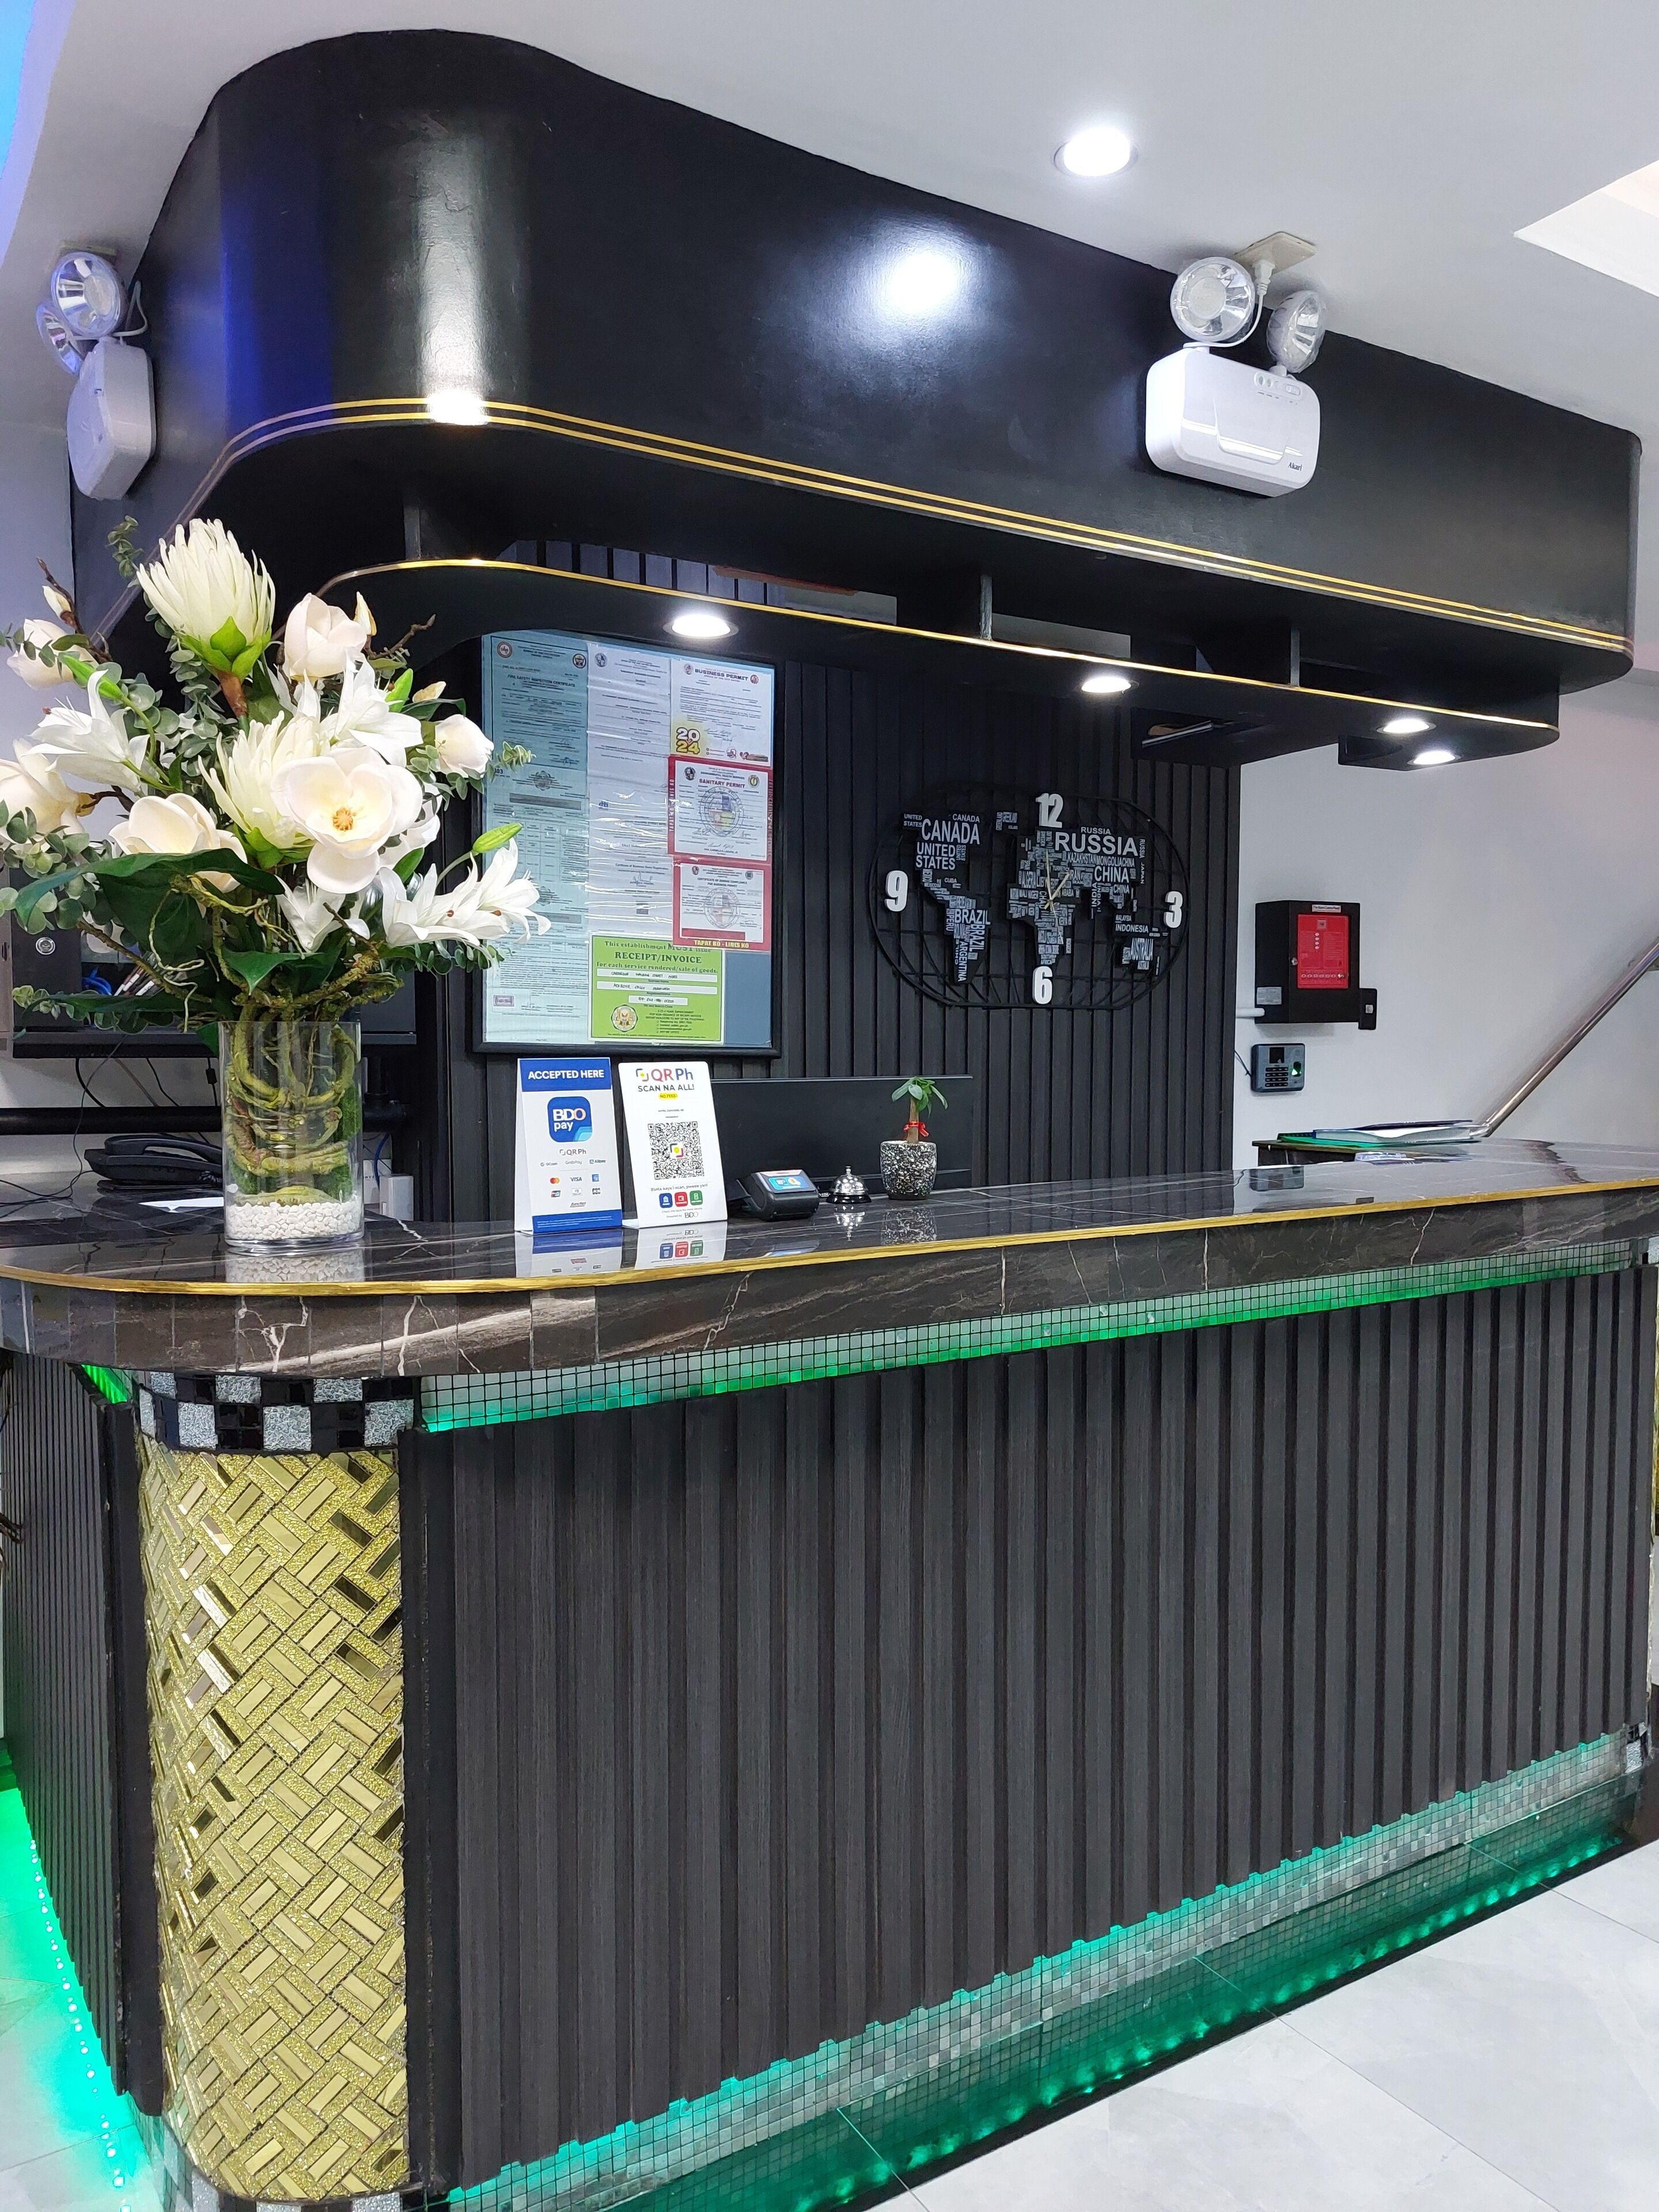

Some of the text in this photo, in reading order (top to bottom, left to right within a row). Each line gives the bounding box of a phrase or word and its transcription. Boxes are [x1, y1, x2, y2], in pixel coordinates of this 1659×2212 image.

[1288, 462, 1302, 471] Akari
[695, 668, 725, 677] BUSINESS
[676, 727, 700, 742] 20
[676, 740, 700, 755] 24
[952, 813, 980, 823] CANADA
[1036, 793, 1063, 828] 12
[922, 819, 980, 844] CANADA
[1081, 827, 1111, 835] RUSSIA
[916, 842, 956, 857] UNITED
[1055, 832, 1138, 856] RUSSIA
[916, 855, 956, 870] STATES
[1067, 852, 1097, 865] KAZAKHSTAN
[1096, 855, 1123, 867] MONGOLIA
[1094, 865, 1130, 883] CHINA
[885, 870, 908, 912] 9
[1113, 884, 1130, 893] CHINA
[955, 908, 991, 925] BRAZIL
[1163, 891, 1183, 929] 3
[945, 915, 955, 931] PERU
[1115, 923, 1149, 933] INDONESIA
[969, 924, 986, 952] BRAZIL
[1130, 937, 1154, 961] AUSTRALIA
[615, 952, 702, 964] RECEIPT/INVOICE
[958, 941, 969, 982] ARGENTINA
[1032, 966, 1053, 1004] 6
[528, 1070, 605, 1080] ACCEPTED HERE
[651, 1068, 694, 1082] QR Ph
[552, 1108, 586, 1122] BDO
[554, 1122, 573, 1132] pay
